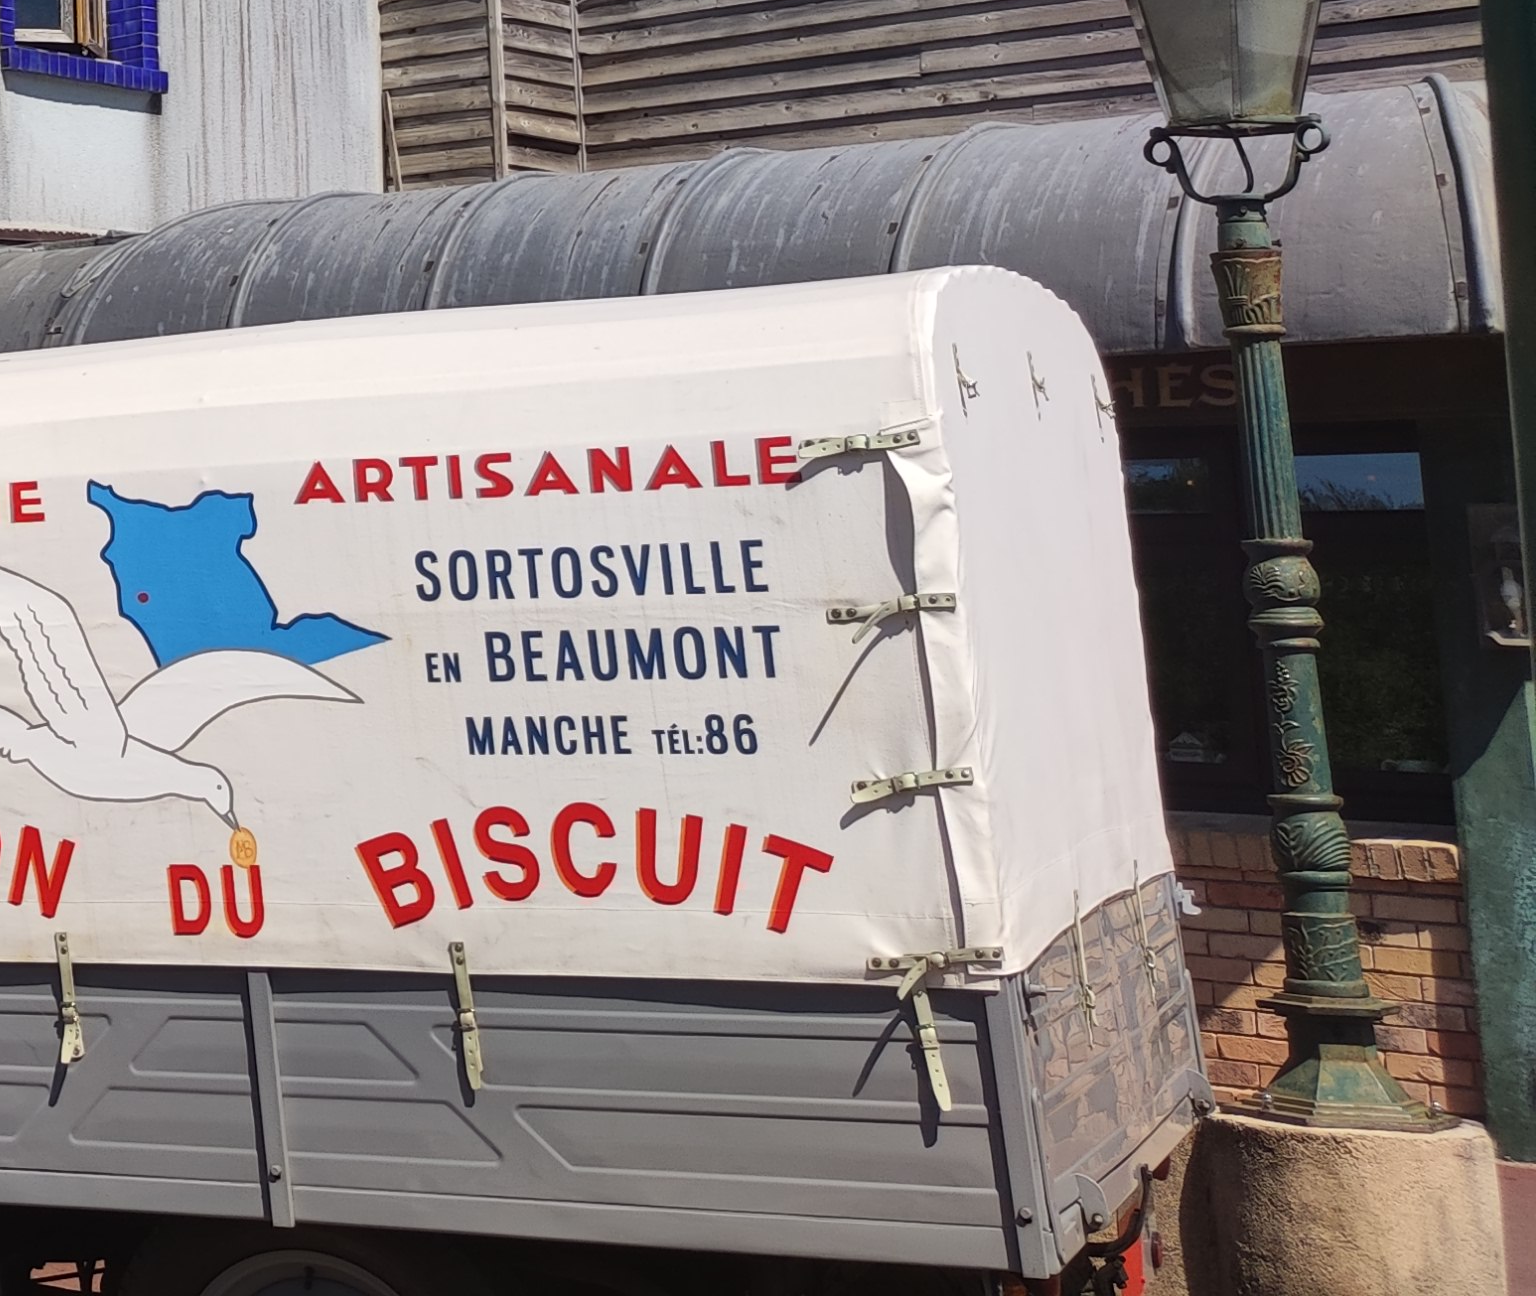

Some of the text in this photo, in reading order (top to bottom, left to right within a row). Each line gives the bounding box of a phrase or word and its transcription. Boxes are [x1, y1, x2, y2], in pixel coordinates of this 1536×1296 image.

[294, 435, 802, 504] ARTISANALE
[415, 539, 770, 603] SORTOSVILLE
[425, 624, 782, 684] EN BEAUMONT
[465, 715, 633, 757] MANCHE
[167, 863, 266, 940] DU
[354, 801, 835, 935] BISCUIT
